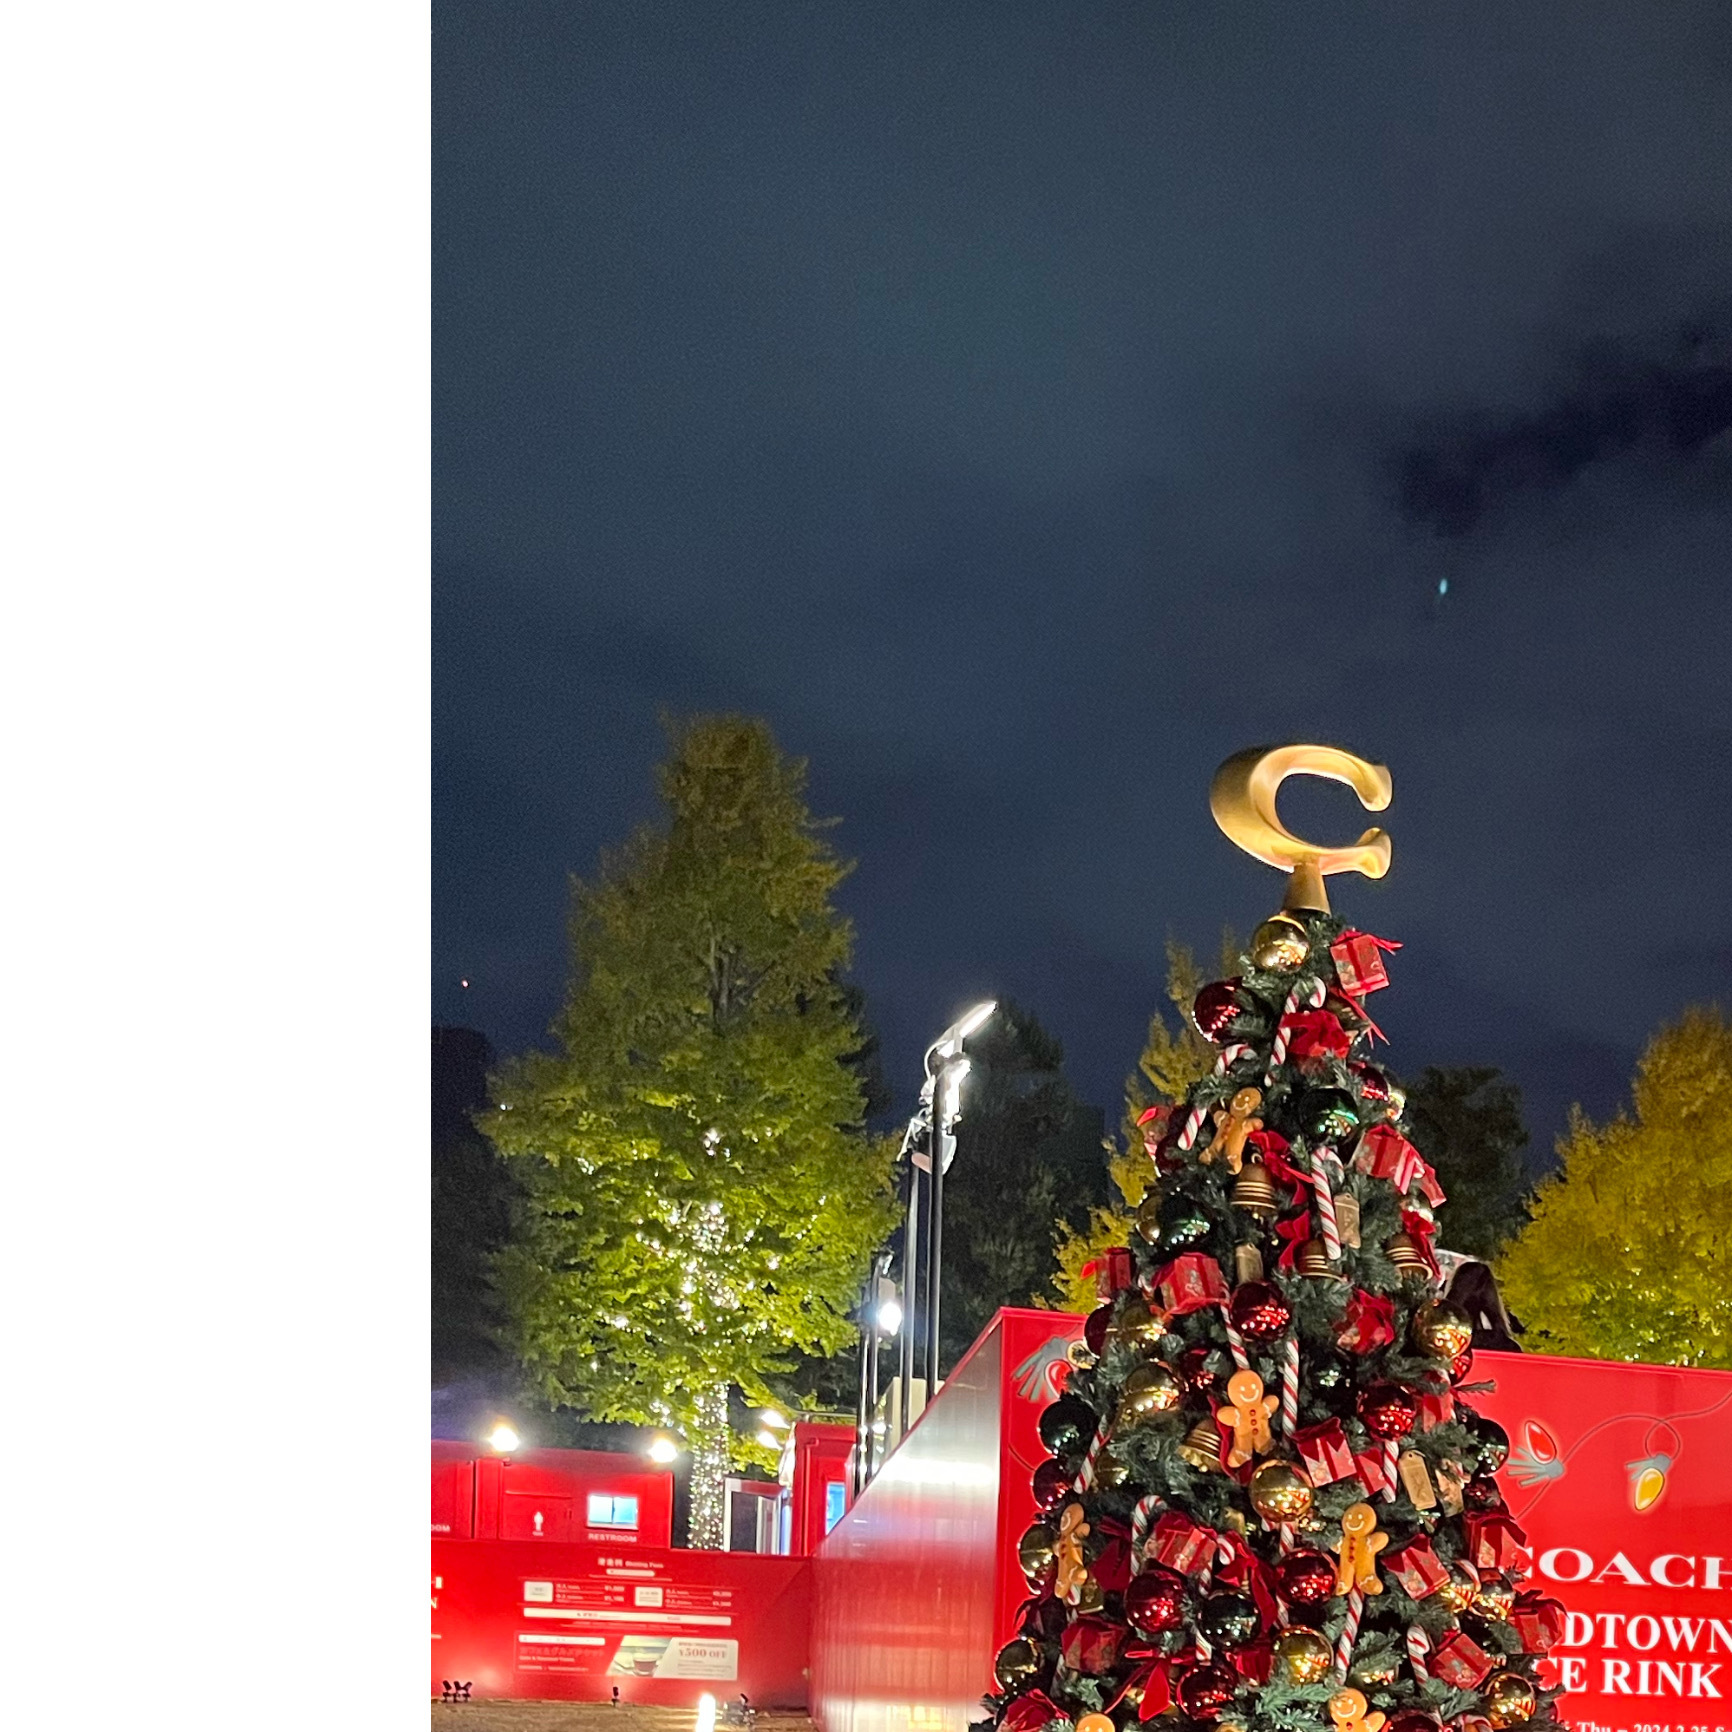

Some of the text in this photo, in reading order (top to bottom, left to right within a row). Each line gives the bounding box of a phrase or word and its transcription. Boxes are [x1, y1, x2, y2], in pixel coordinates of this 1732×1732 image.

[588, 1533, 638, 1543] RESTROOM
[1529, 1656, 1722, 1698] CE RINK
